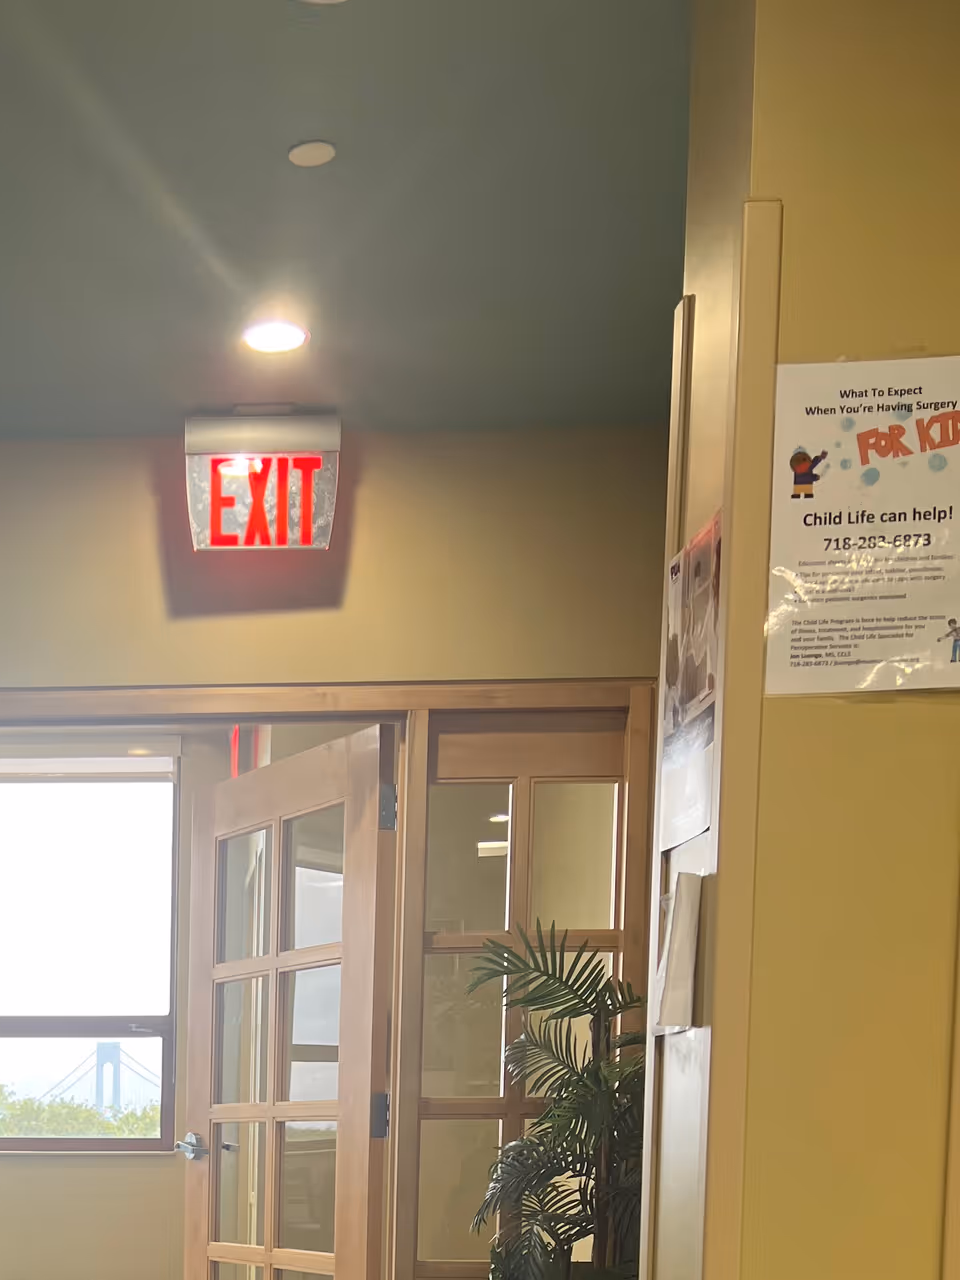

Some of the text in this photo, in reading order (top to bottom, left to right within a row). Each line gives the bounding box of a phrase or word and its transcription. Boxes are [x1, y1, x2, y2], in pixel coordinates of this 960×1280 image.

[840, 386, 923, 399] What To Expect
[805, 400, 958, 416] When You're Having Surgery
[856, 424, 915, 466] FOR
[209, 456, 323, 547] EXIT
[803, 505, 953, 527] Child Life can help!
